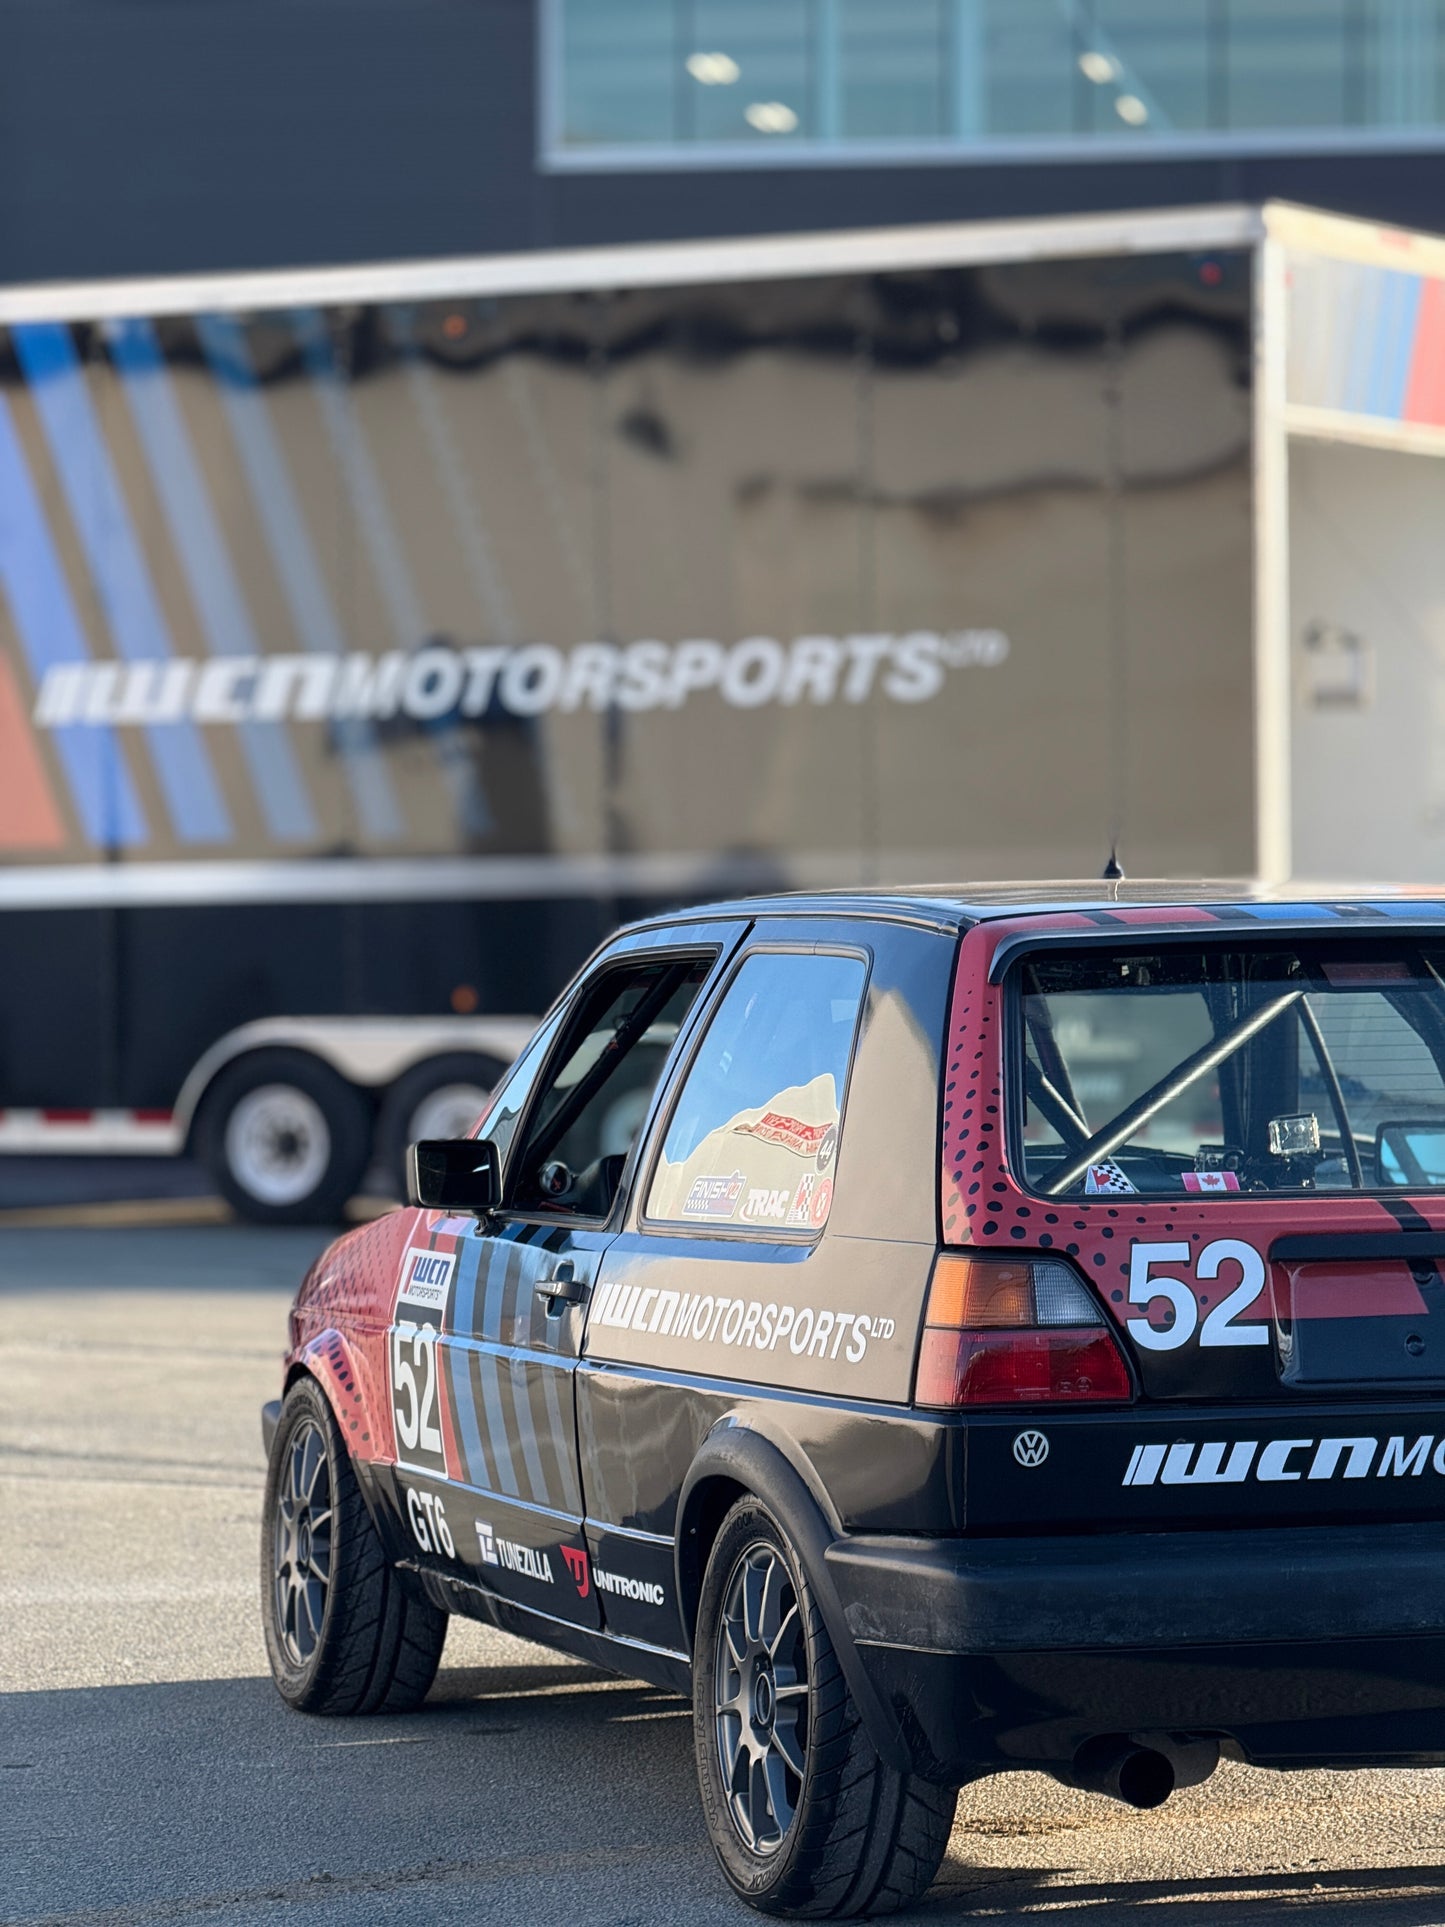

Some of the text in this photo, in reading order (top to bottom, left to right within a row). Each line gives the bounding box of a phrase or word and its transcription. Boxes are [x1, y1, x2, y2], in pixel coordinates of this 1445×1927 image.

[329, 631, 944, 721] MOTORSPORTS
[746, 1188, 790, 1218] TRAC
[671, 1292, 870, 1363] MOTORSPORTS
[870, 1316, 896, 1340] LTD
[1125, 1238, 1270, 1351] 52
[393, 1319, 442, 1454] 52
[407, 1487, 455, 1559] GT6
[496, 1537, 554, 1584] TUNEZILLA
[592, 1567, 664, 1606] UNITRONIC
